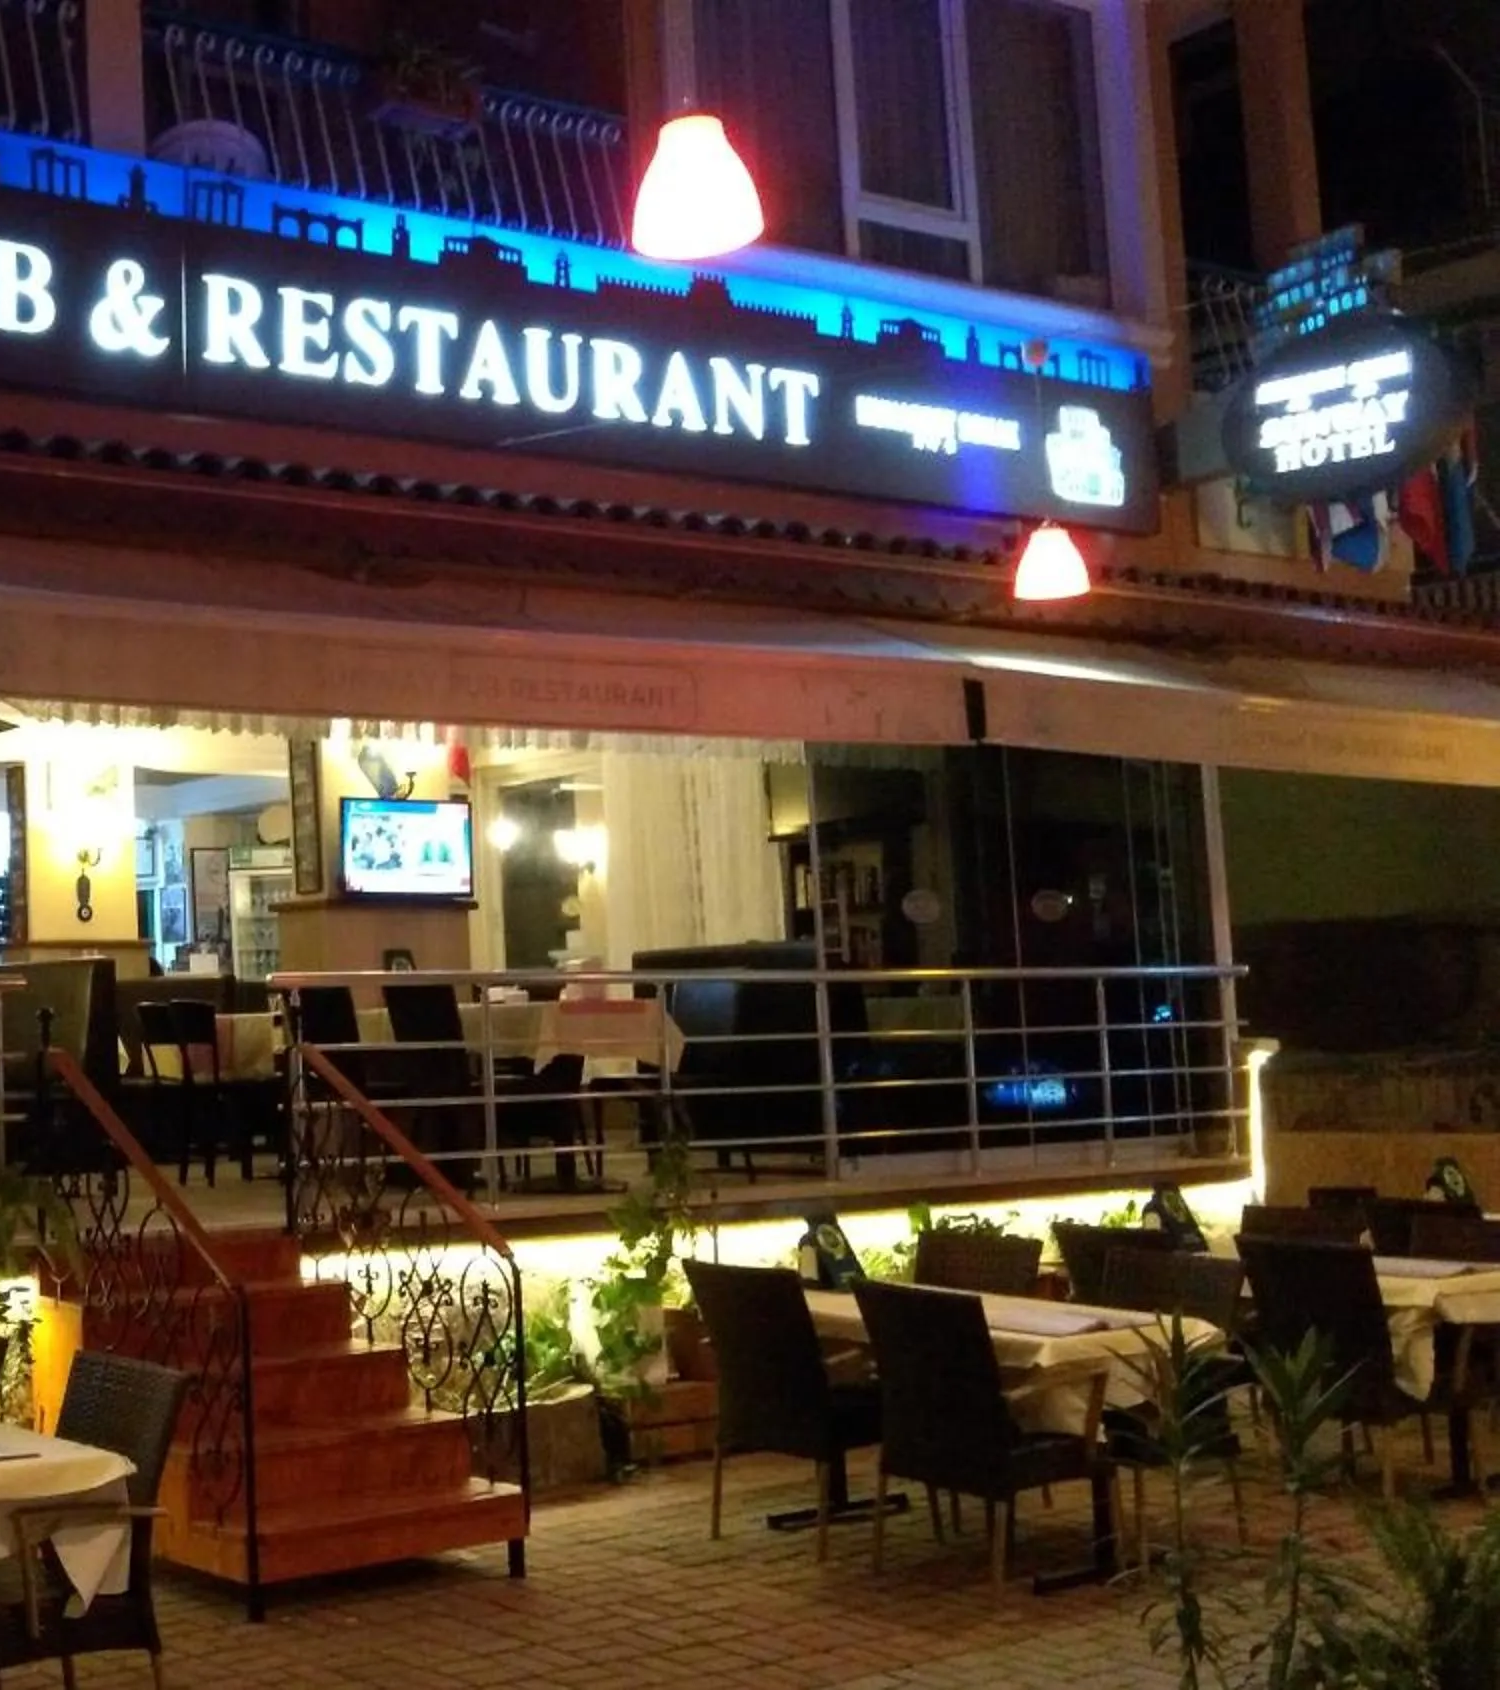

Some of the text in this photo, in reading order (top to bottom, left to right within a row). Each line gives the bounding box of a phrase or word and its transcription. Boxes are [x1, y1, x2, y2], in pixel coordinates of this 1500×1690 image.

[88, 258, 171, 358] &
[201, 273, 820, 447] RESTAURANT
[1274, 424, 1396, 473] HOTEL
